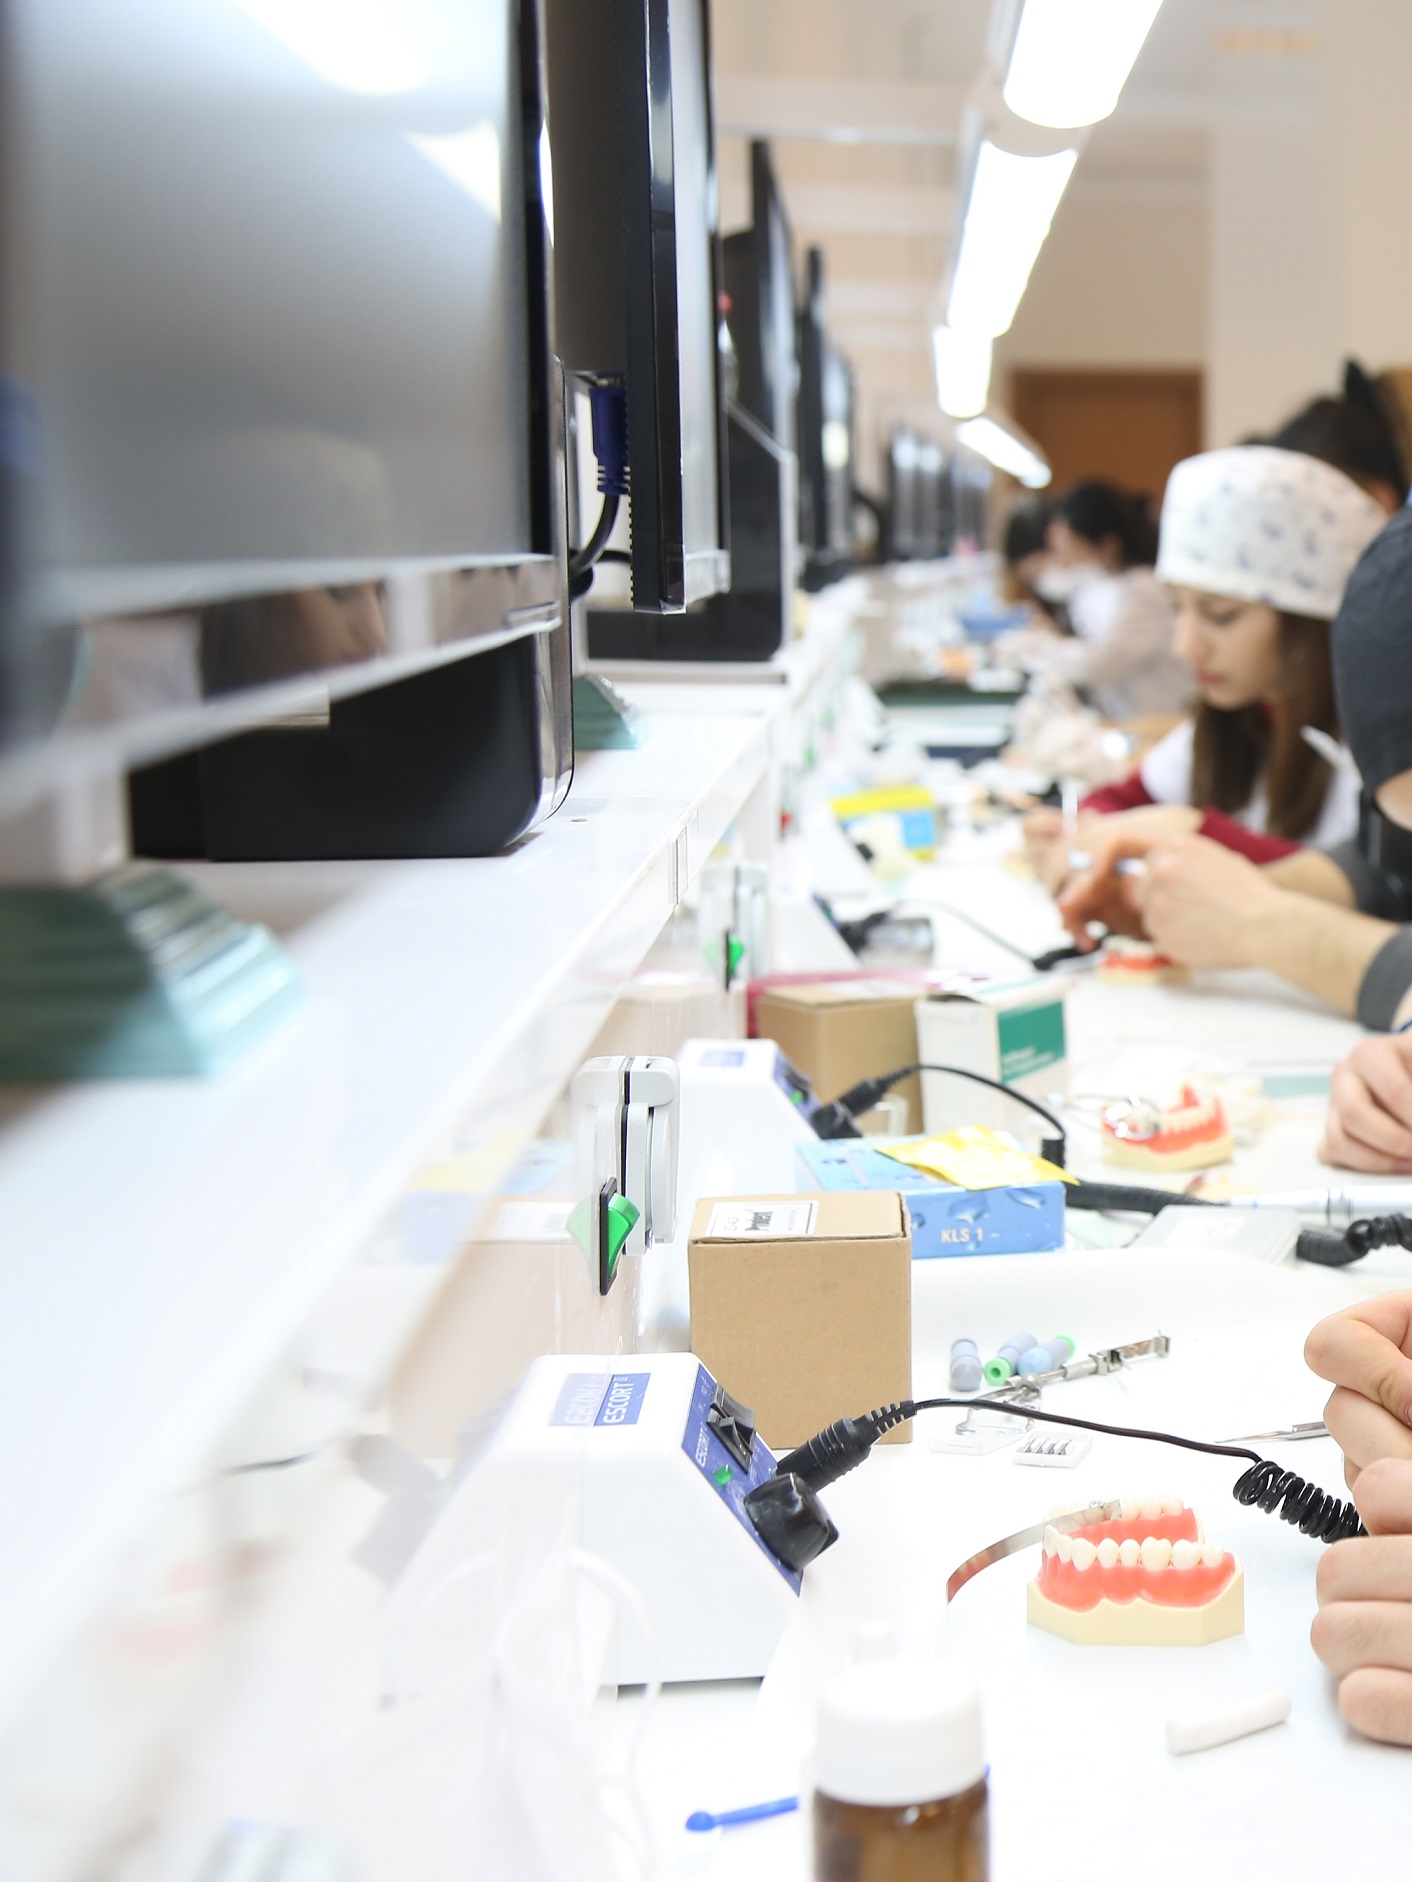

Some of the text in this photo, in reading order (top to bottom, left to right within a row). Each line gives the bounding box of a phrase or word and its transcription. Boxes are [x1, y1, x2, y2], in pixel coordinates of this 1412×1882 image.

[940, 1226, 984, 1243] KLS 1
[602, 1381, 636, 1424] ESCORT
